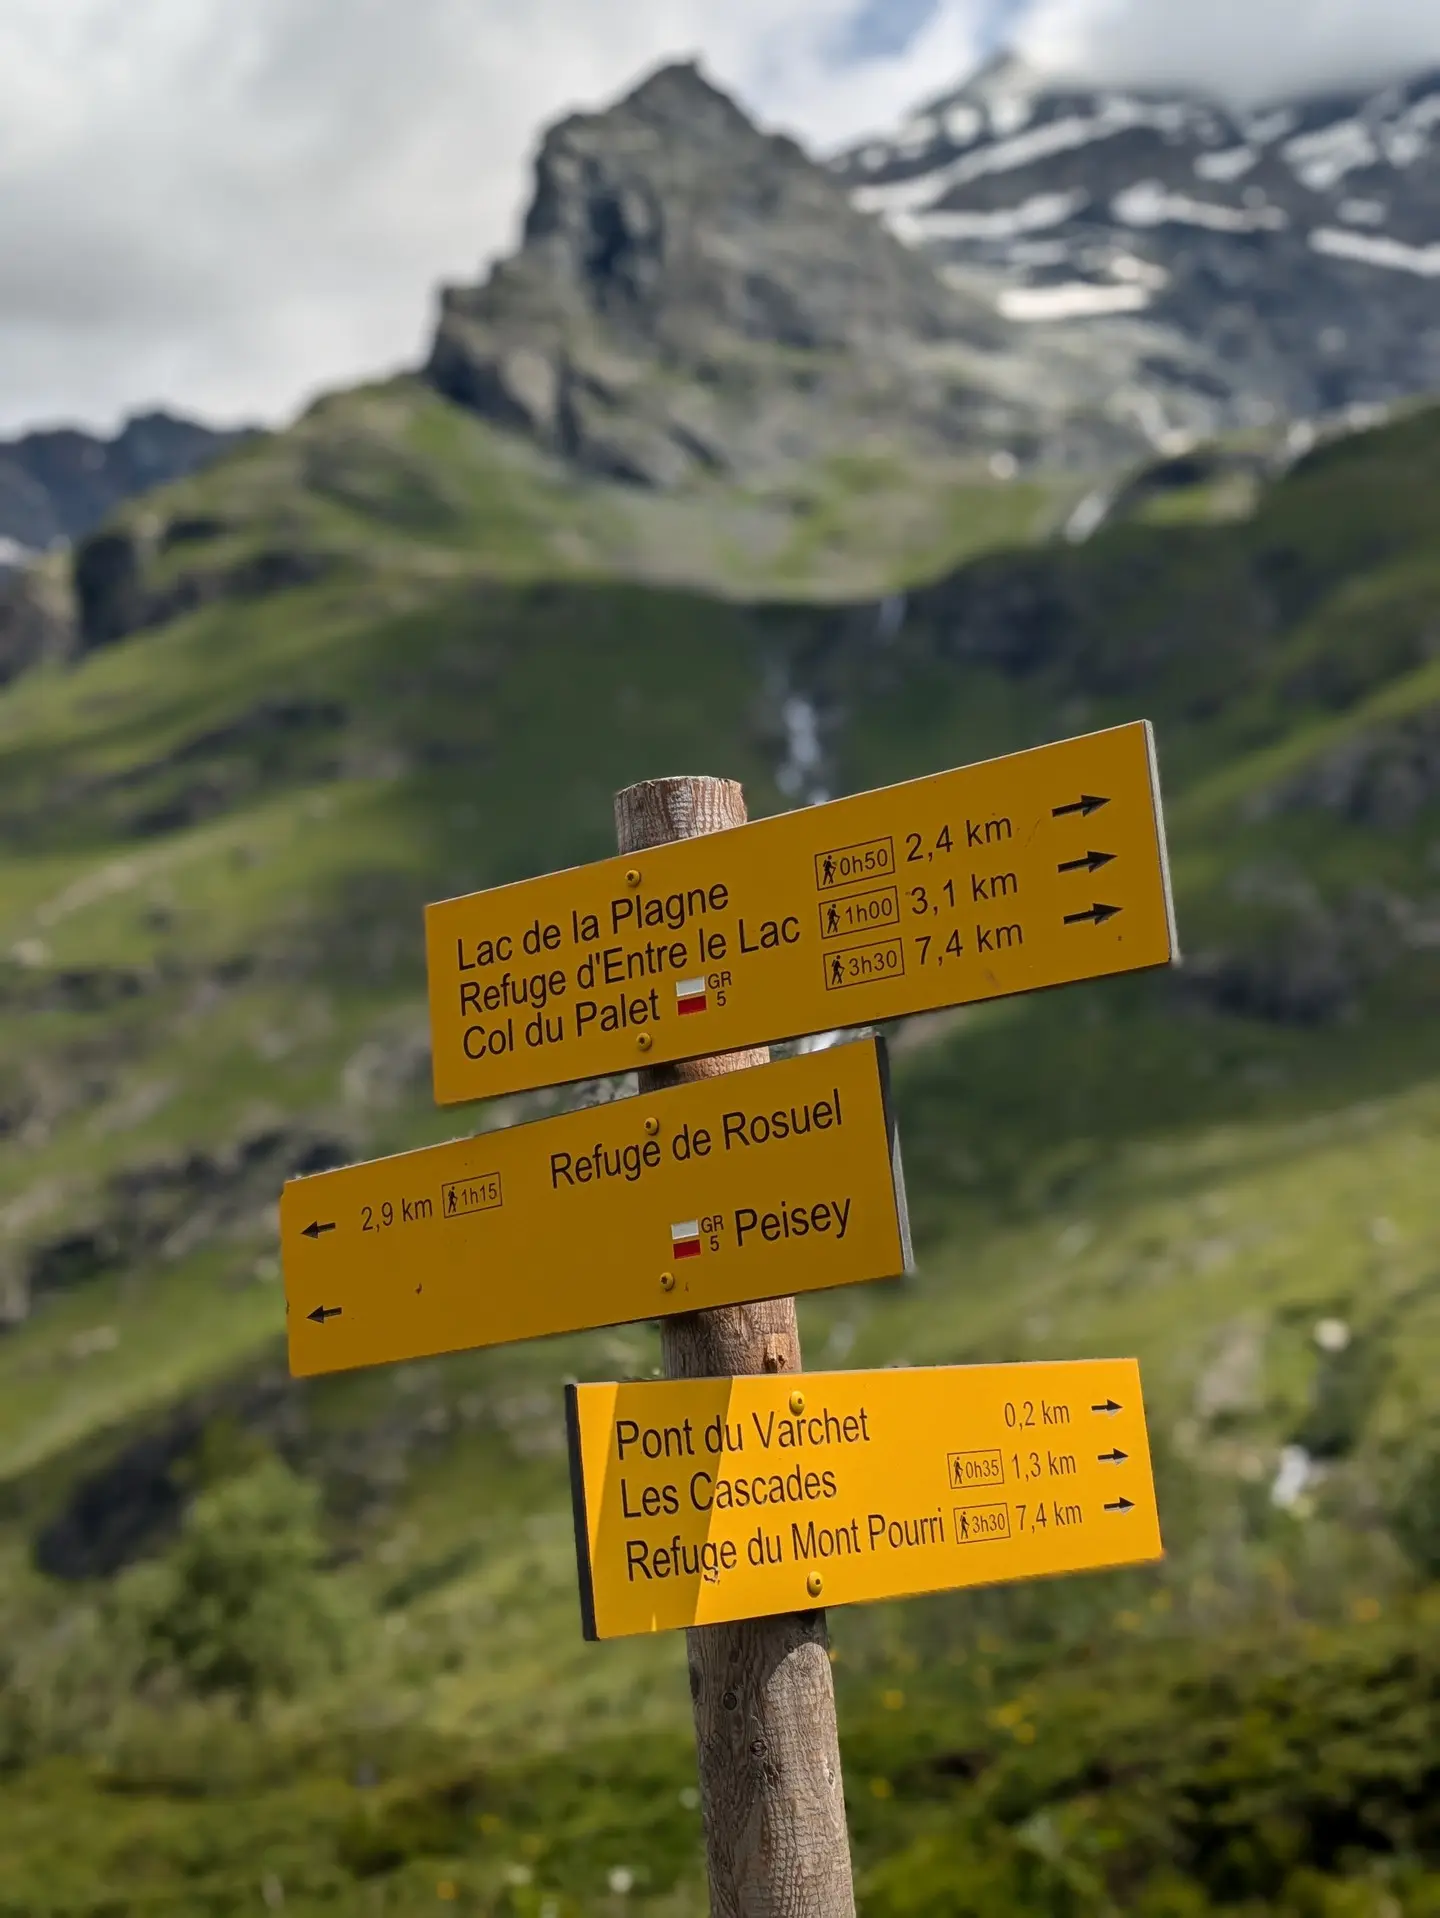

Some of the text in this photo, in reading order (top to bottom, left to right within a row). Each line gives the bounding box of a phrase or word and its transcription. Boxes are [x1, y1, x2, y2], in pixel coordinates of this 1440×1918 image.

[906, 818, 1011, 861] 2,4 km
[839, 848, 889, 876] 0h50
[911, 873, 1017, 914] 3,1 km
[458, 882, 728, 970] Lac de la Plagne
[844, 897, 894, 926] 1h00
[916, 925, 1022, 965] 7,4 km
[461, 917, 799, 1016] Refuge d'Entre le Lac
[849, 950, 897, 976] 3h30
[708, 971, 731, 989] GR
[717, 991, 726, 1006] 5
[464, 989, 660, 1059] Col du Palet
[551, 1088, 841, 1188] Refuge de Rosuel
[462, 1183, 497, 1205] 1h15
[362, 1199, 432, 1231] 2,9 km
[701, 1215, 723, 1233] GR
[735, 1199, 850, 1246] Peisey
[711, 1235, 719, 1251] 5
[1005, 1401, 1069, 1429] 0,2 km
[617, 1408, 869, 1460] Pont du Varchet
[966, 1460, 999, 1478] 0h35
[1013, 1452, 1076, 1481] 1,3 km
[621, 1464, 836, 1518] Les Cascades
[972, 1513, 1005, 1533] 3h30
[1016, 1502, 1082, 1533] 7,4 km
[627, 1508, 944, 1582] Refuge du Mont Pourri
